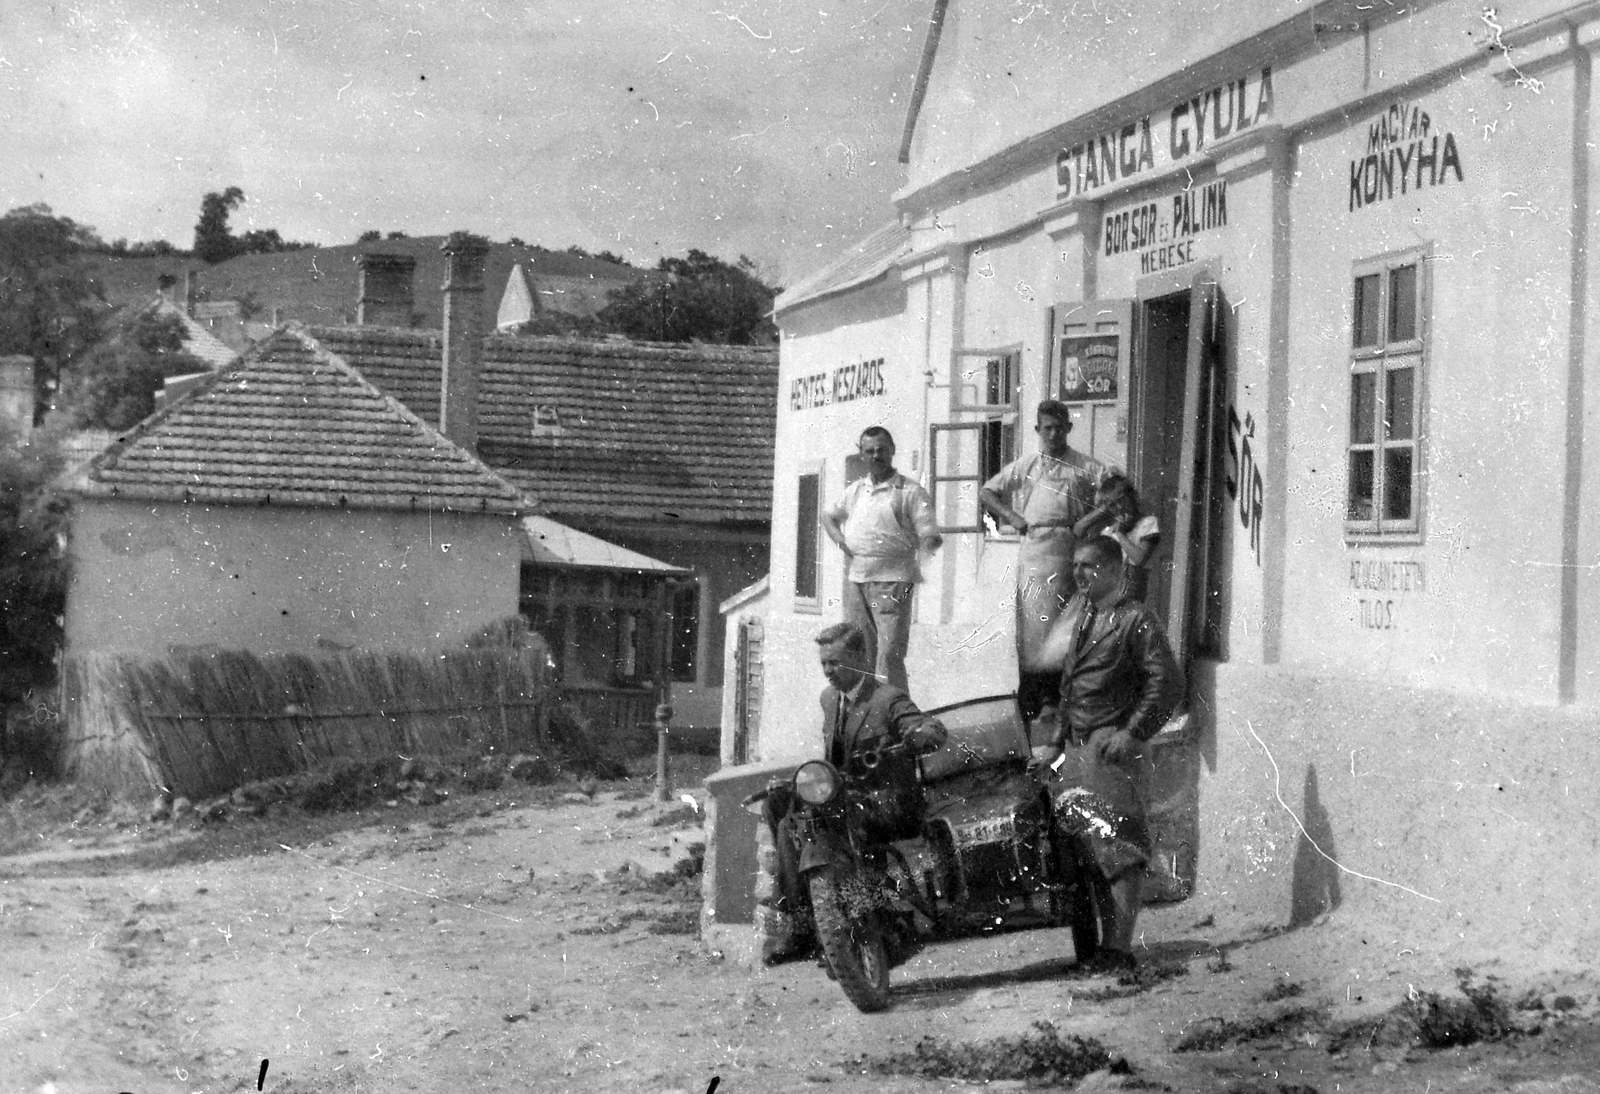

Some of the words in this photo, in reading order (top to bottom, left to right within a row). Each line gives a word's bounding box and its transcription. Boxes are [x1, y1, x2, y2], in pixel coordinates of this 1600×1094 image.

[1056, 117, 1154, 201] STANGA
[1170, 66, 1275, 161] GYULA
[1349, 132, 1464, 213] KONYHA
[1226, 404, 1264, 568] SÖR
